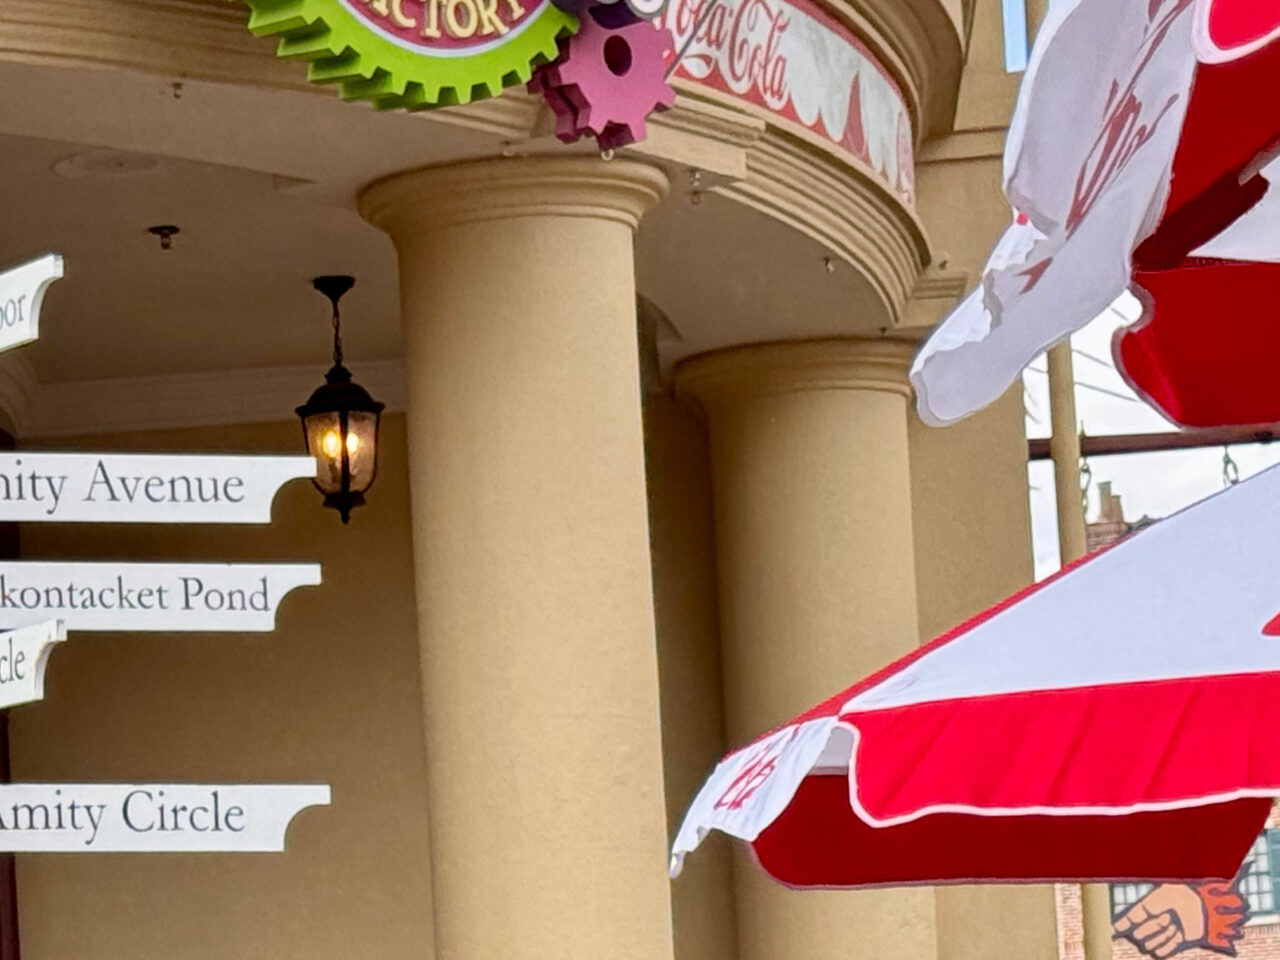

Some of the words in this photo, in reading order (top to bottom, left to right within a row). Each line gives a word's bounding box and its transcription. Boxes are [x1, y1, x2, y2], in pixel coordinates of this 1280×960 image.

[661, 0, 788, 101] oca-Cola
[82, 459, 245, 504] Avenue
[178, 575, 272, 613] Pond
[121, 789, 245, 834] Circle
